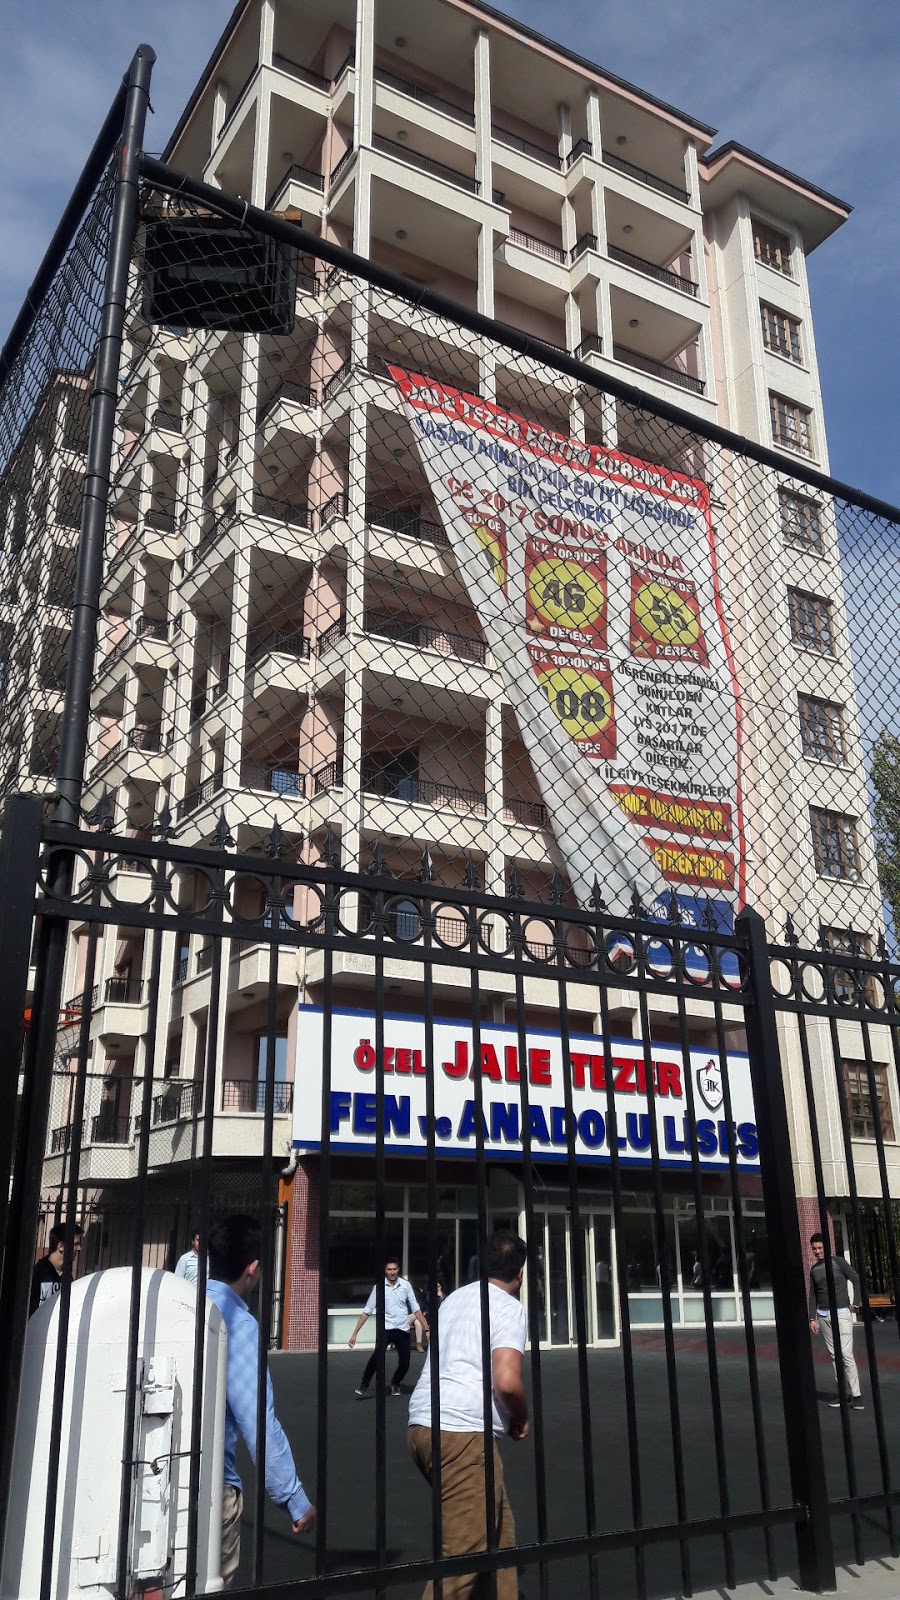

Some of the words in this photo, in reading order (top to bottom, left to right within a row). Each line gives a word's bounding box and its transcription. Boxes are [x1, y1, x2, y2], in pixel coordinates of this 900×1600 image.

[406, 384, 456, 412] JALE
[460, 399, 521, 440] TEZER
[481, 488, 526, 521] 2017
[573, 477, 595, 499] EN
[543, 579, 586, 613] 46
[651, 596, 689, 632] 55
[656, 644, 700, 661] DERECE
[637, 684, 703, 703] GÖNÜLDEN
[645, 702, 693, 718] KUTLAR
[634, 715, 652, 729] LYS
[354, 1039, 427, 1075] ÖZEL
[442, 1041, 552, 1086] JALE
[569, 1052, 683, 1097] TEZER
[329, 1091, 411, 1140] FEN
[416, 1115, 454, 1140] ve
[456, 1100, 651, 1154] ANADOLU
